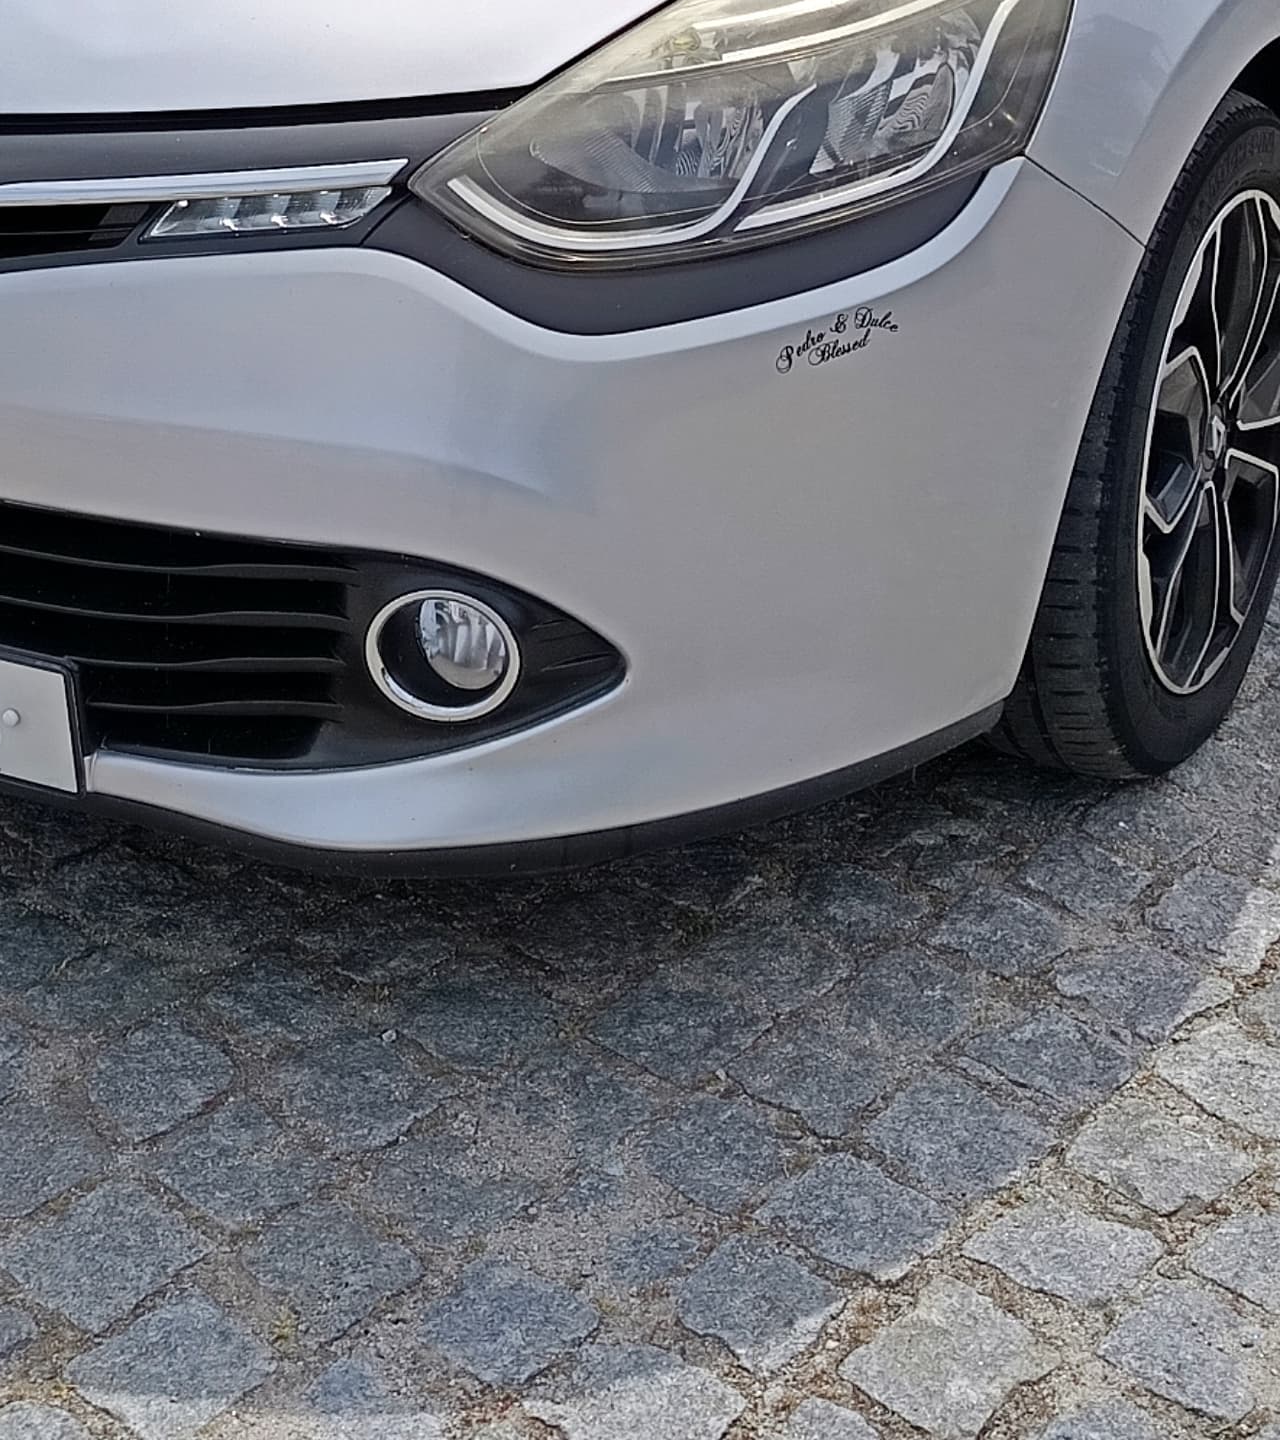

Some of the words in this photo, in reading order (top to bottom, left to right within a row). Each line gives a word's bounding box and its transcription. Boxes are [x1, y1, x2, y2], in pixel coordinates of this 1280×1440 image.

[776, 330, 826, 373] Pedro
[829, 314, 848, 333] &
[854, 307, 898, 332] Dulce
[808, 328, 871, 366] Blessed
